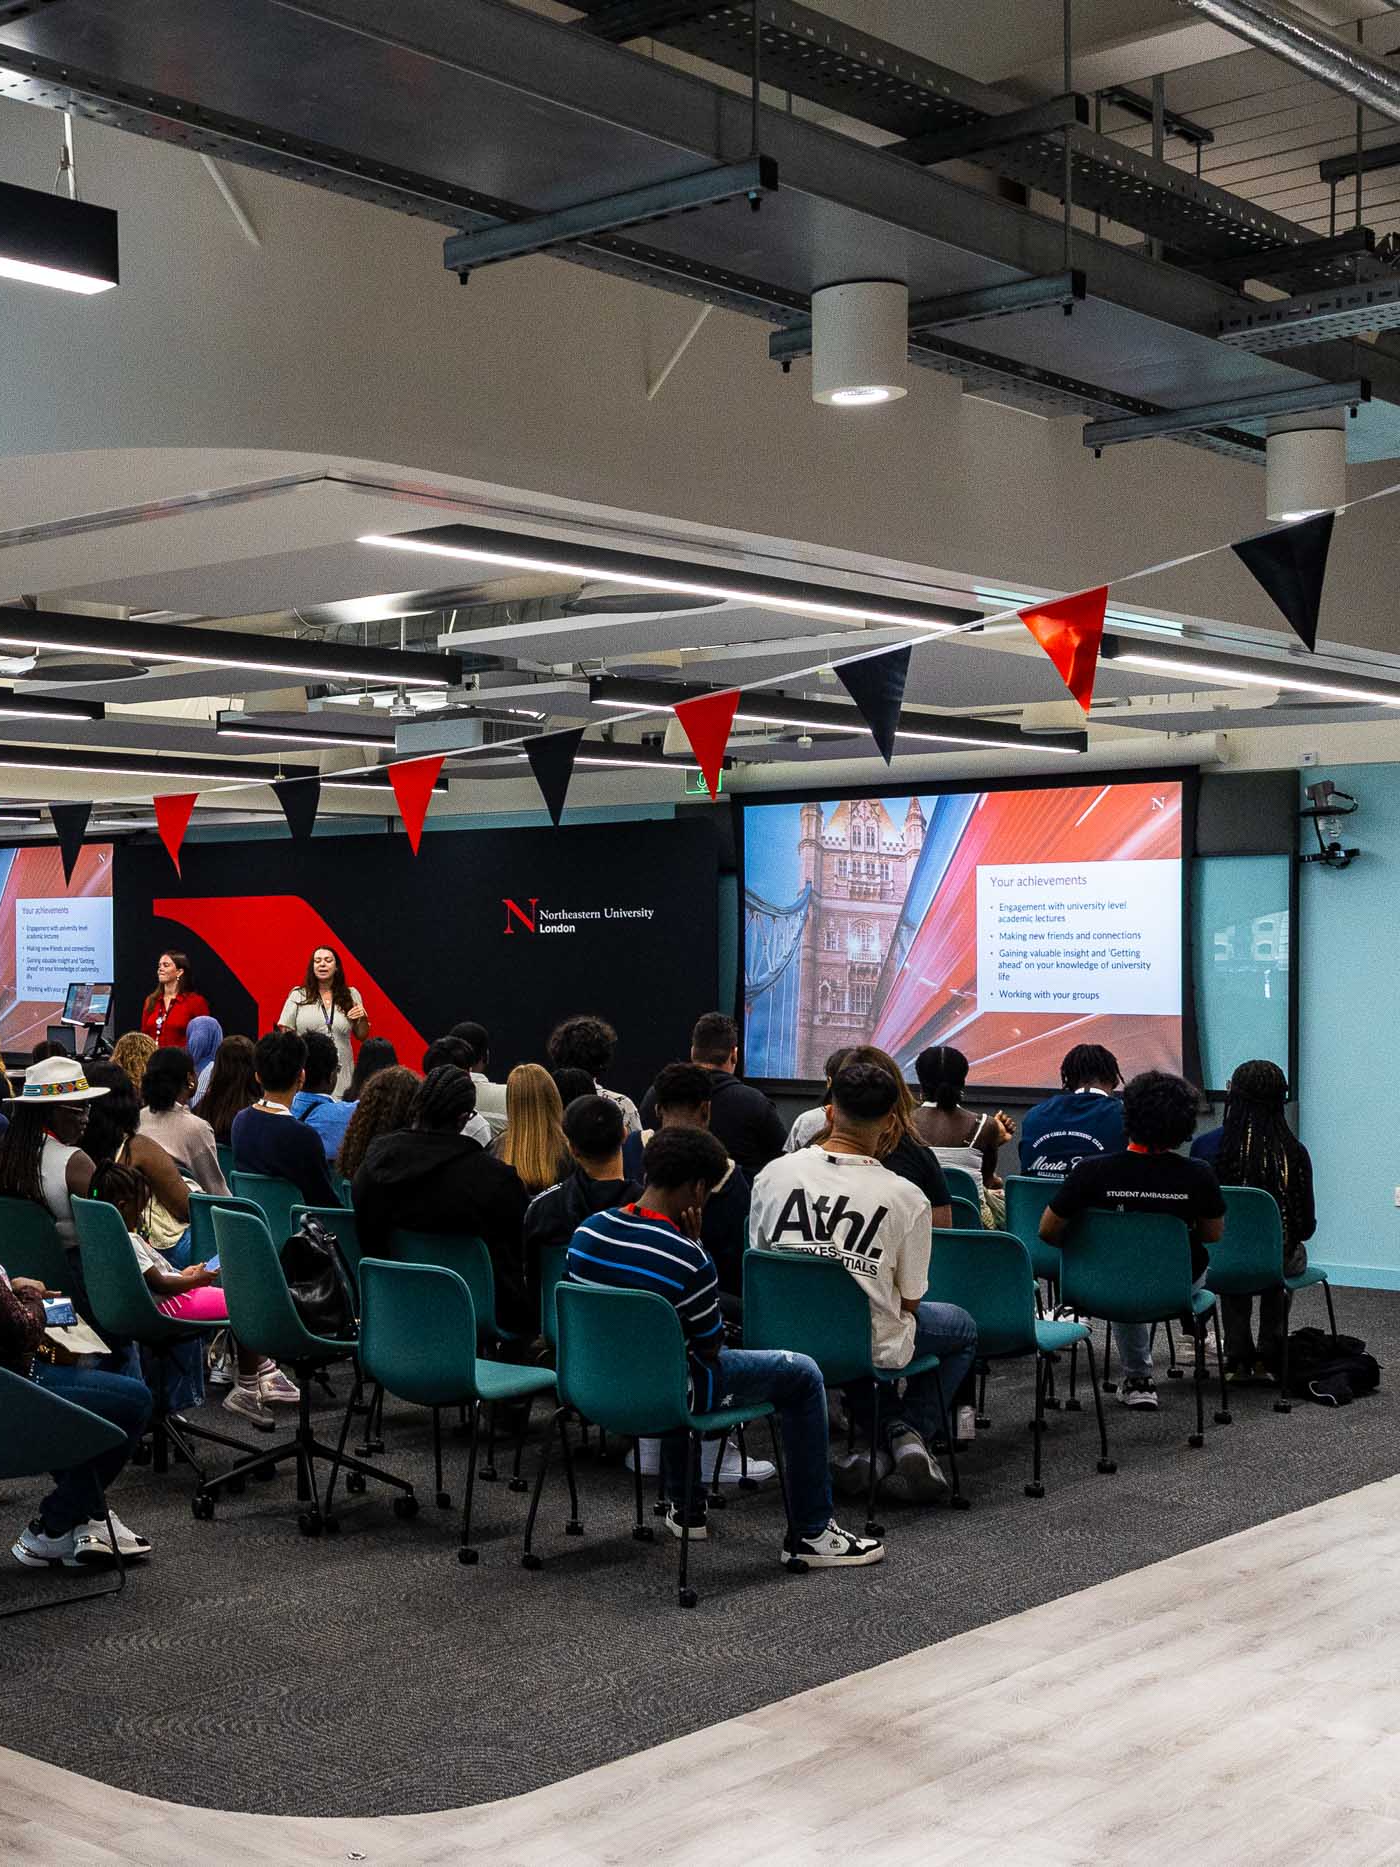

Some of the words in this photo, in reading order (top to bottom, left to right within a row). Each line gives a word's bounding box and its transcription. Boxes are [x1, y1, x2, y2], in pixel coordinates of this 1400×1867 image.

[1151, 796, 1166, 810] N
[990, 876, 1014, 888] Your
[1016, 874, 1088, 887] achievements
[999, 902, 1046, 912] Engagement
[1048, 902, 1065, 911] with
[1067, 902, 1105, 912] university
[1107, 901, 1127, 910] level
[502, 898, 539, 934] N
[539, 909, 601, 920] Northeastern
[604, 907, 654, 920] University
[998, 914, 1033, 923] academic
[1035, 914, 1066, 923] lectures
[540, 924, 576, 934] London
[999, 932, 1027, 942] Making
[1047, 932, 1074, 940] friends
[1076, 932, 1091, 940] and
[1092, 932, 1141, 940] connections
[999, 949, 1028, 959] Gaining
[1030, 949, 1062, 958] valuable
[1063, 949, 1089, 959] insight
[1091, 949, 1106, 958] and
[1036, 962, 1054, 971] your
[1056, 961, 1098, 971] knowledge
[1100, 960, 1110, 969] of
[1111, 960, 1151, 970] university
[998, 972, 1010, 981] life
[999, 990, 1032, 1000] Working
[1033, 990, 1051, 999] with
[1052, 992, 1070, 1001] your
[1072, 992, 1100, 1001] groups
[1028, 1156, 1068, 1171] Monte
[1106, 1190, 1140, 1198] STUDENT
[1140, 1191, 1189, 1200] AMBASSADOR
